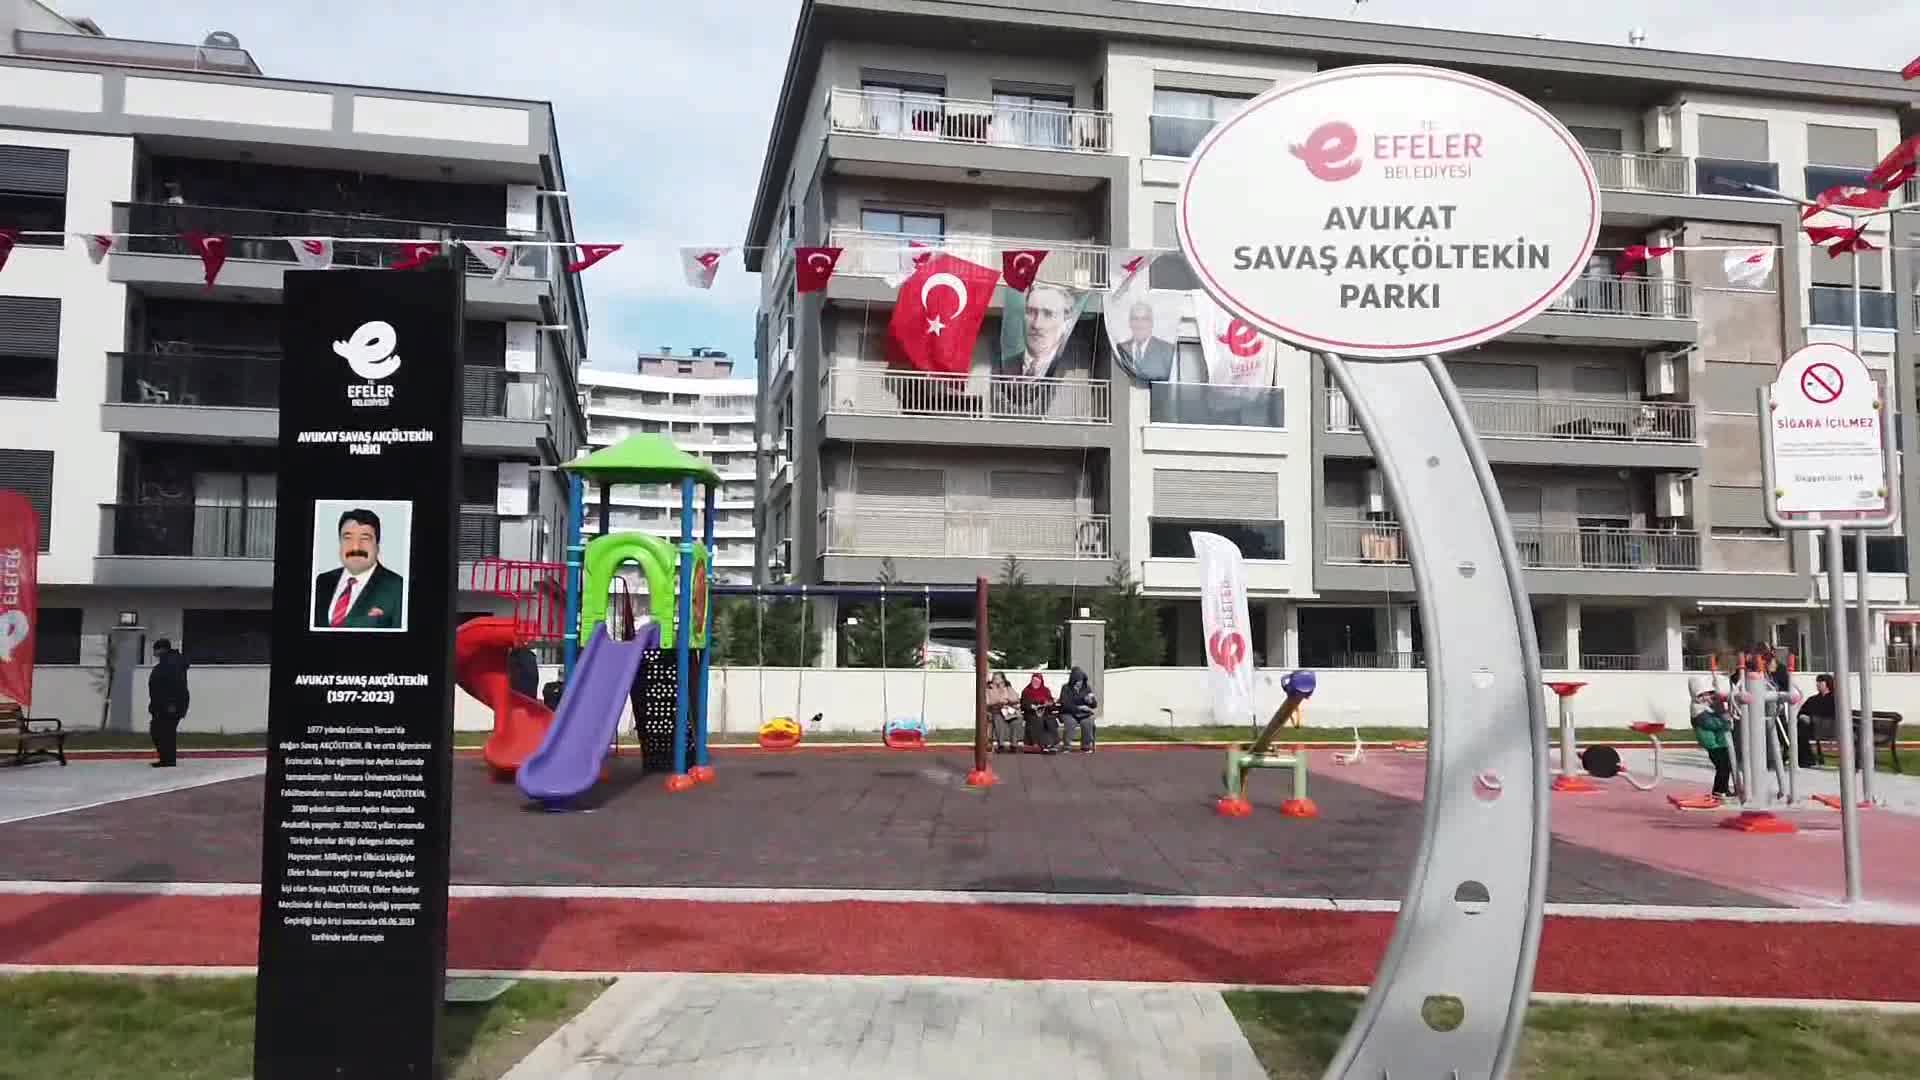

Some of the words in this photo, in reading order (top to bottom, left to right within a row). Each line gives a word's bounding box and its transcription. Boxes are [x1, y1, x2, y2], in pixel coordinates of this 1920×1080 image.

[1374, 133, 1484, 160] EFELER
[1384, 165, 1473, 180] BELEDİYESİ
[1323, 204, 1457, 231] AVUKAT
[1233, 244, 1338, 276] SAVAŞ
[1345, 236, 1550, 276] AKÇÖLTEKİN
[1339, 283, 1441, 309] PARKI
[347, 385, 395, 398] EFELER
[1776, 415, 1822, 429] SİGARA
[1825, 415, 1873, 429] İÇİLMEZ
[298, 431, 338, 443] AVUKAT
[338, 431, 371, 444] SAVAŞ
[372, 428, 433, 444] AKÇÖLTEKİN
[350, 443, 381, 455] PARKI
[296, 675, 335, 686] AVUKAT
[335, 675, 367, 688] SAVAŞ
[368, 673, 428, 688] AKÇÖLTEKİN
[327, 690, 395, 704] (1977-2023)
